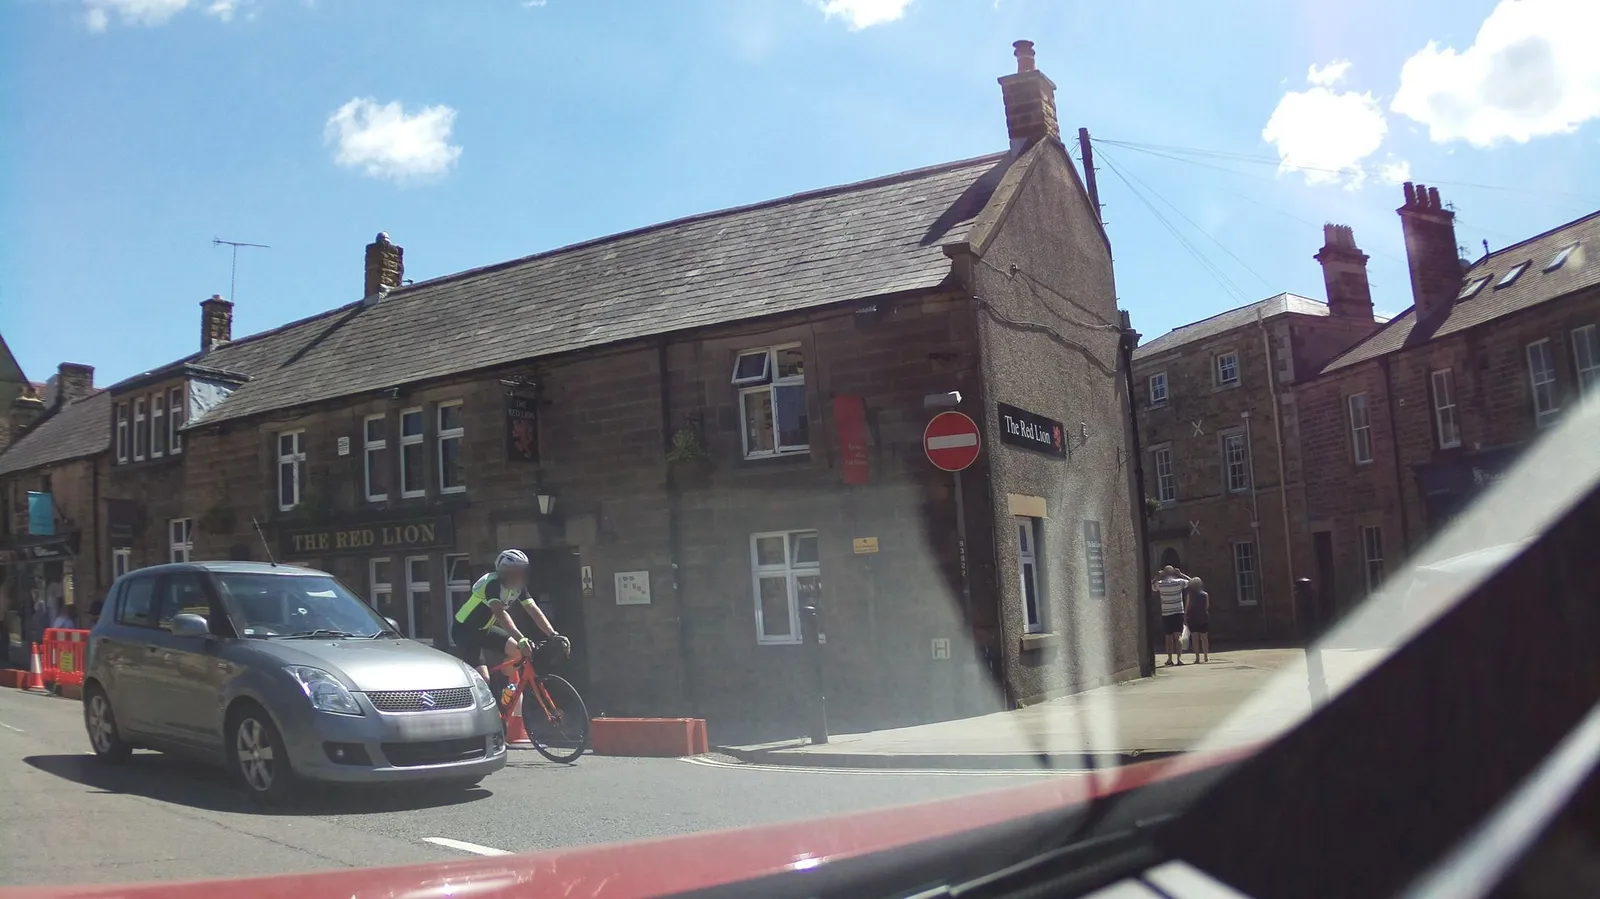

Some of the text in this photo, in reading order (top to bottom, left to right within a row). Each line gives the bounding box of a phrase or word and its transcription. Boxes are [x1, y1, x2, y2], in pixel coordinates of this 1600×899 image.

[508, 408, 536, 419] RED LION
[1004, 415, 1051, 444] The Red Lion
[292, 523, 436, 551] THE RED LION
